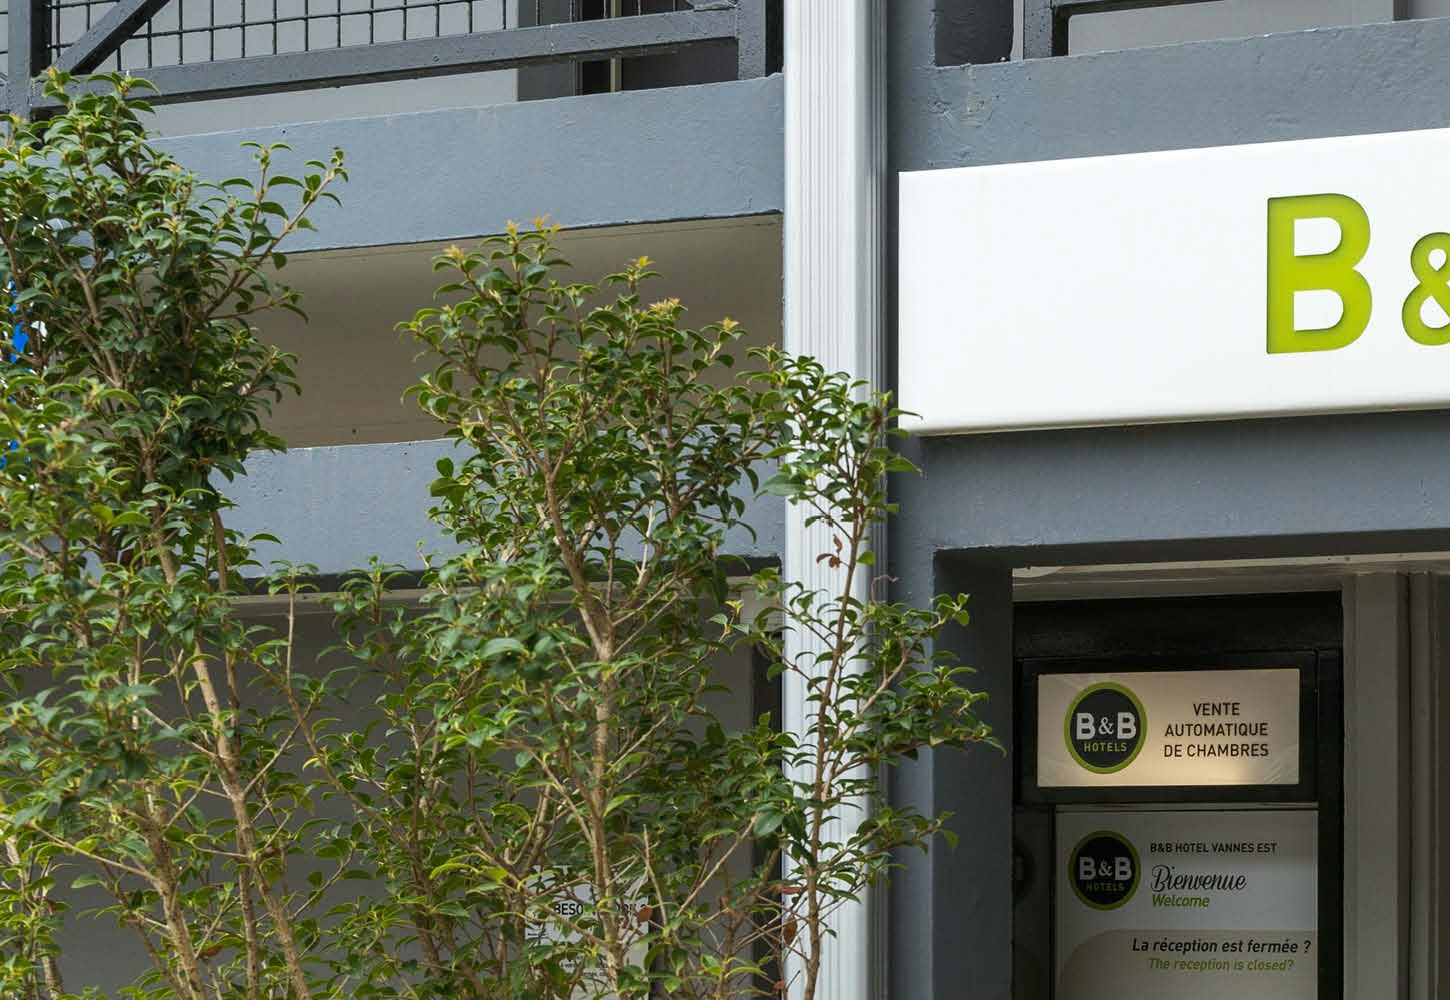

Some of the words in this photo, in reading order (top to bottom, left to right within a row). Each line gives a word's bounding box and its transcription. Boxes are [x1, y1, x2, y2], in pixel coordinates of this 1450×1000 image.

[1193, 702, 1241, 717] VENTE
[1076, 711, 1137, 740] B&B
[1164, 723, 1268, 738] AUTOMATIQUE
[1083, 742, 1128, 753] HOTELS
[1164, 744, 1182, 758] DE
[1186, 743, 1270, 758] CHAMBRES
[1150, 842, 1173, 853] B&B
[1175, 842, 1209, 853] HOTEL
[1211, 842, 1254, 853] VANNES
[1257, 842, 1278, 853] EST
[1079, 856, 1133, 881] B&B
[1151, 864, 1248, 893] Bienvenue
[1085, 882, 1125, 892] HOTELS
[1151, 894, 1210, 908] Welcome
[1132, 938, 1149, 952] La
[1153, 936, 1218, 956] réception
[1222, 939, 1244, 952] est
[1247, 937, 1299, 952] fermée
[1303, 940, 1312, 953] ?
[1149, 958, 1171, 970] The
[1173, 958, 1230, 974] reception
[1233, 959, 1245, 971] is
[1247, 959, 1294, 971] closed?
